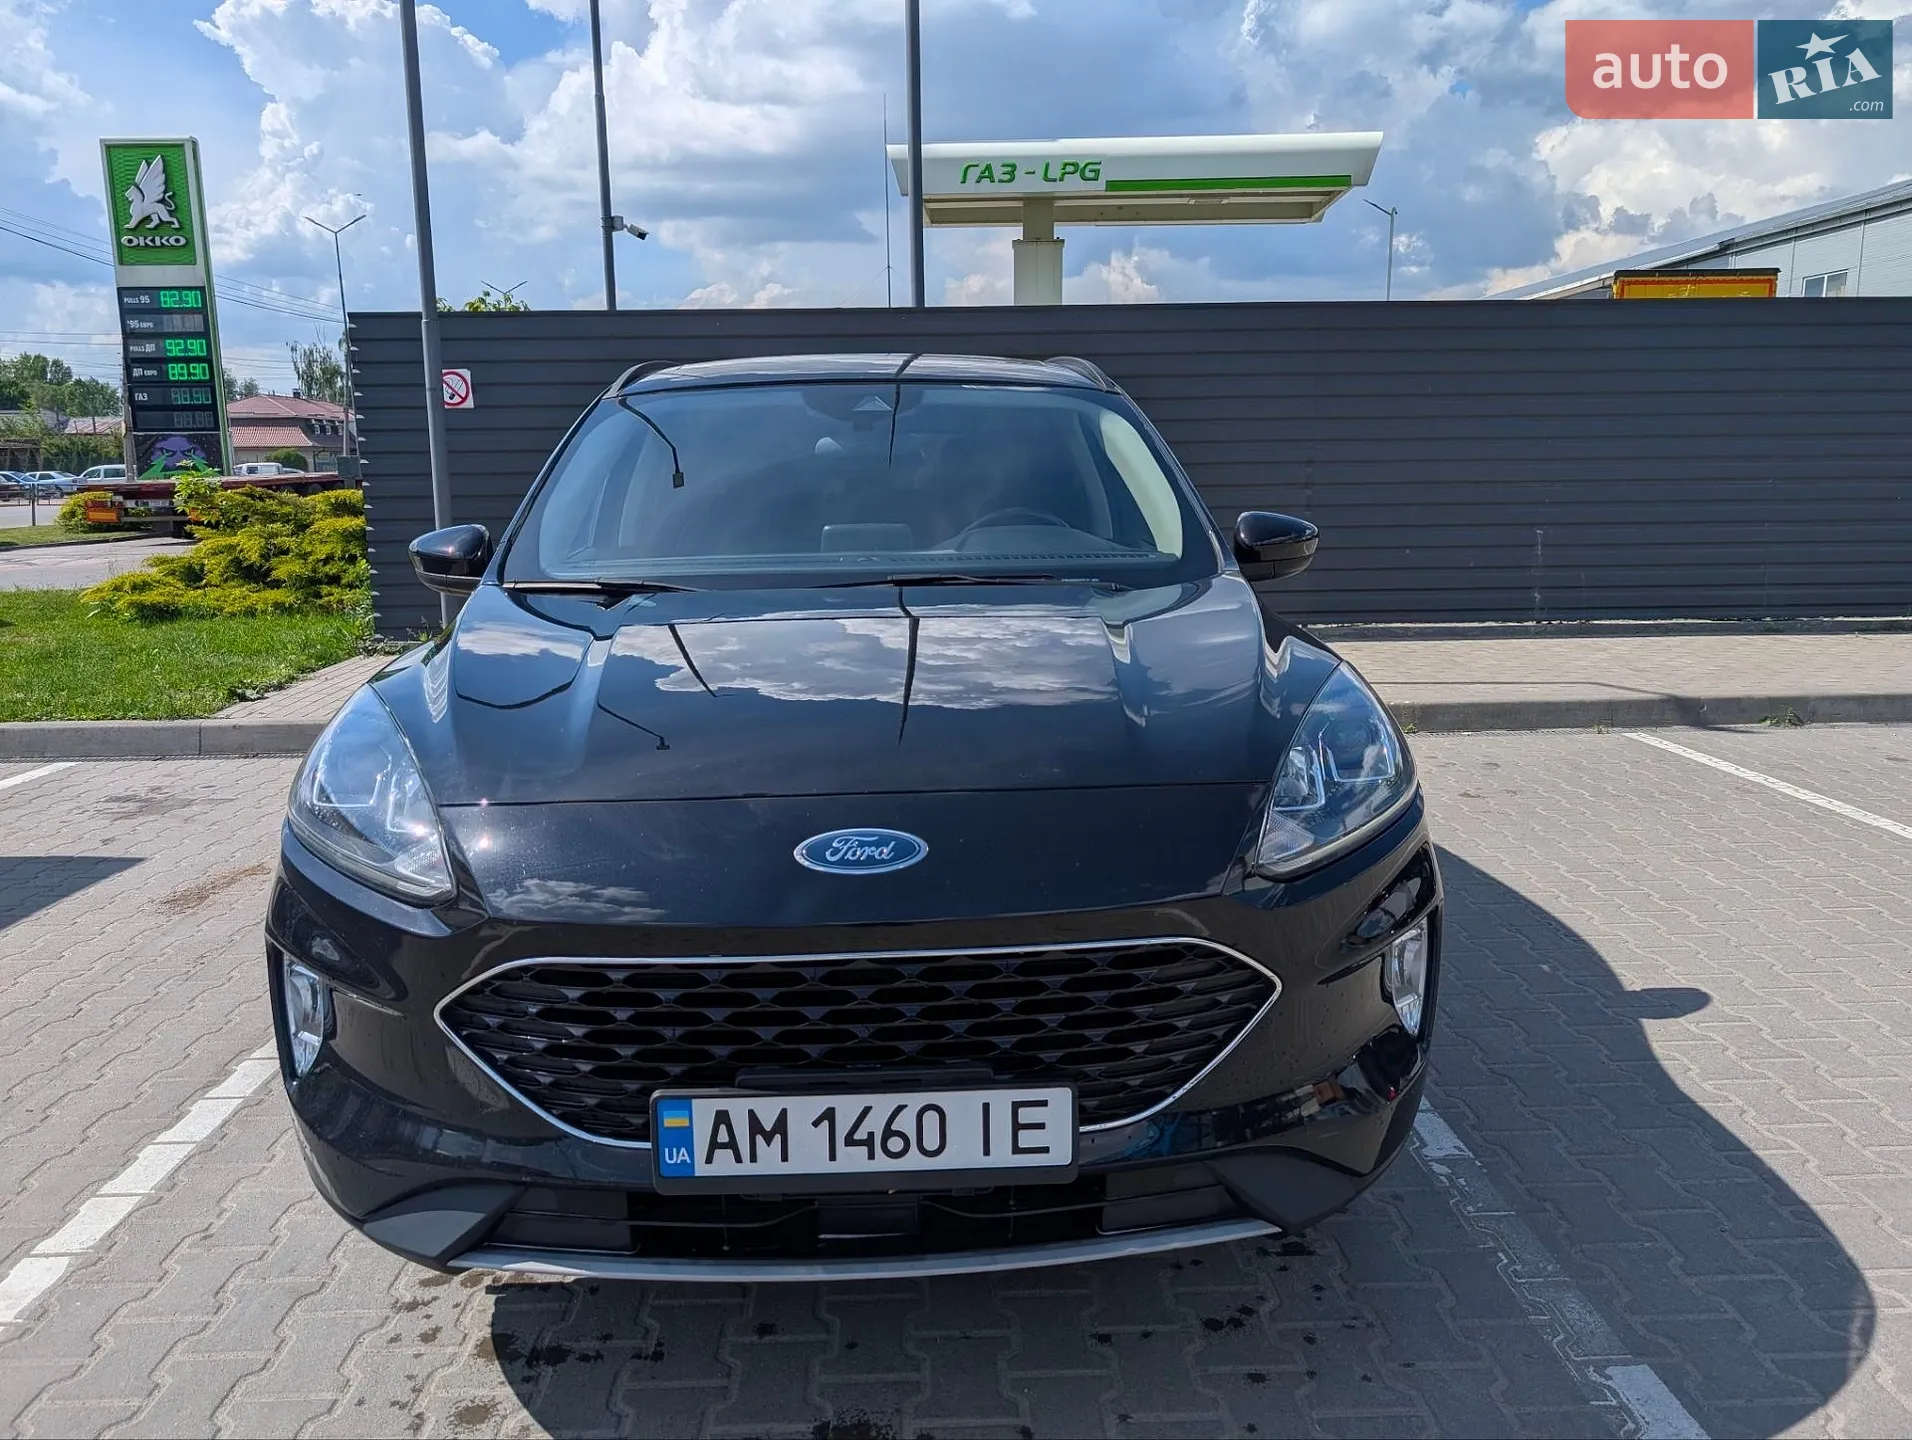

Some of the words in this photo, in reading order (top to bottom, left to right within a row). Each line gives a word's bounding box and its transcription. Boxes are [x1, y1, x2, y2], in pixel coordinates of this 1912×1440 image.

[960, 163, 1017, 184] ГАЗ
[1042, 161, 1102, 182] LPG
[121, 235, 187, 247] OKKO
[139, 295, 151, 304] 95
[160, 290, 201, 307] 82.90
[165, 339, 207, 356] 92.90
[168, 363, 209, 380] 89.90
[134, 392, 149, 401] ГАЗ
[825, 835, 897, 862] Ford
[664, 1147, 691, 1164] UA
[704, 1107, 789, 1165] AM
[810, 1103, 947, 1162] 1460
[981, 1099, 1051, 1157] IE
